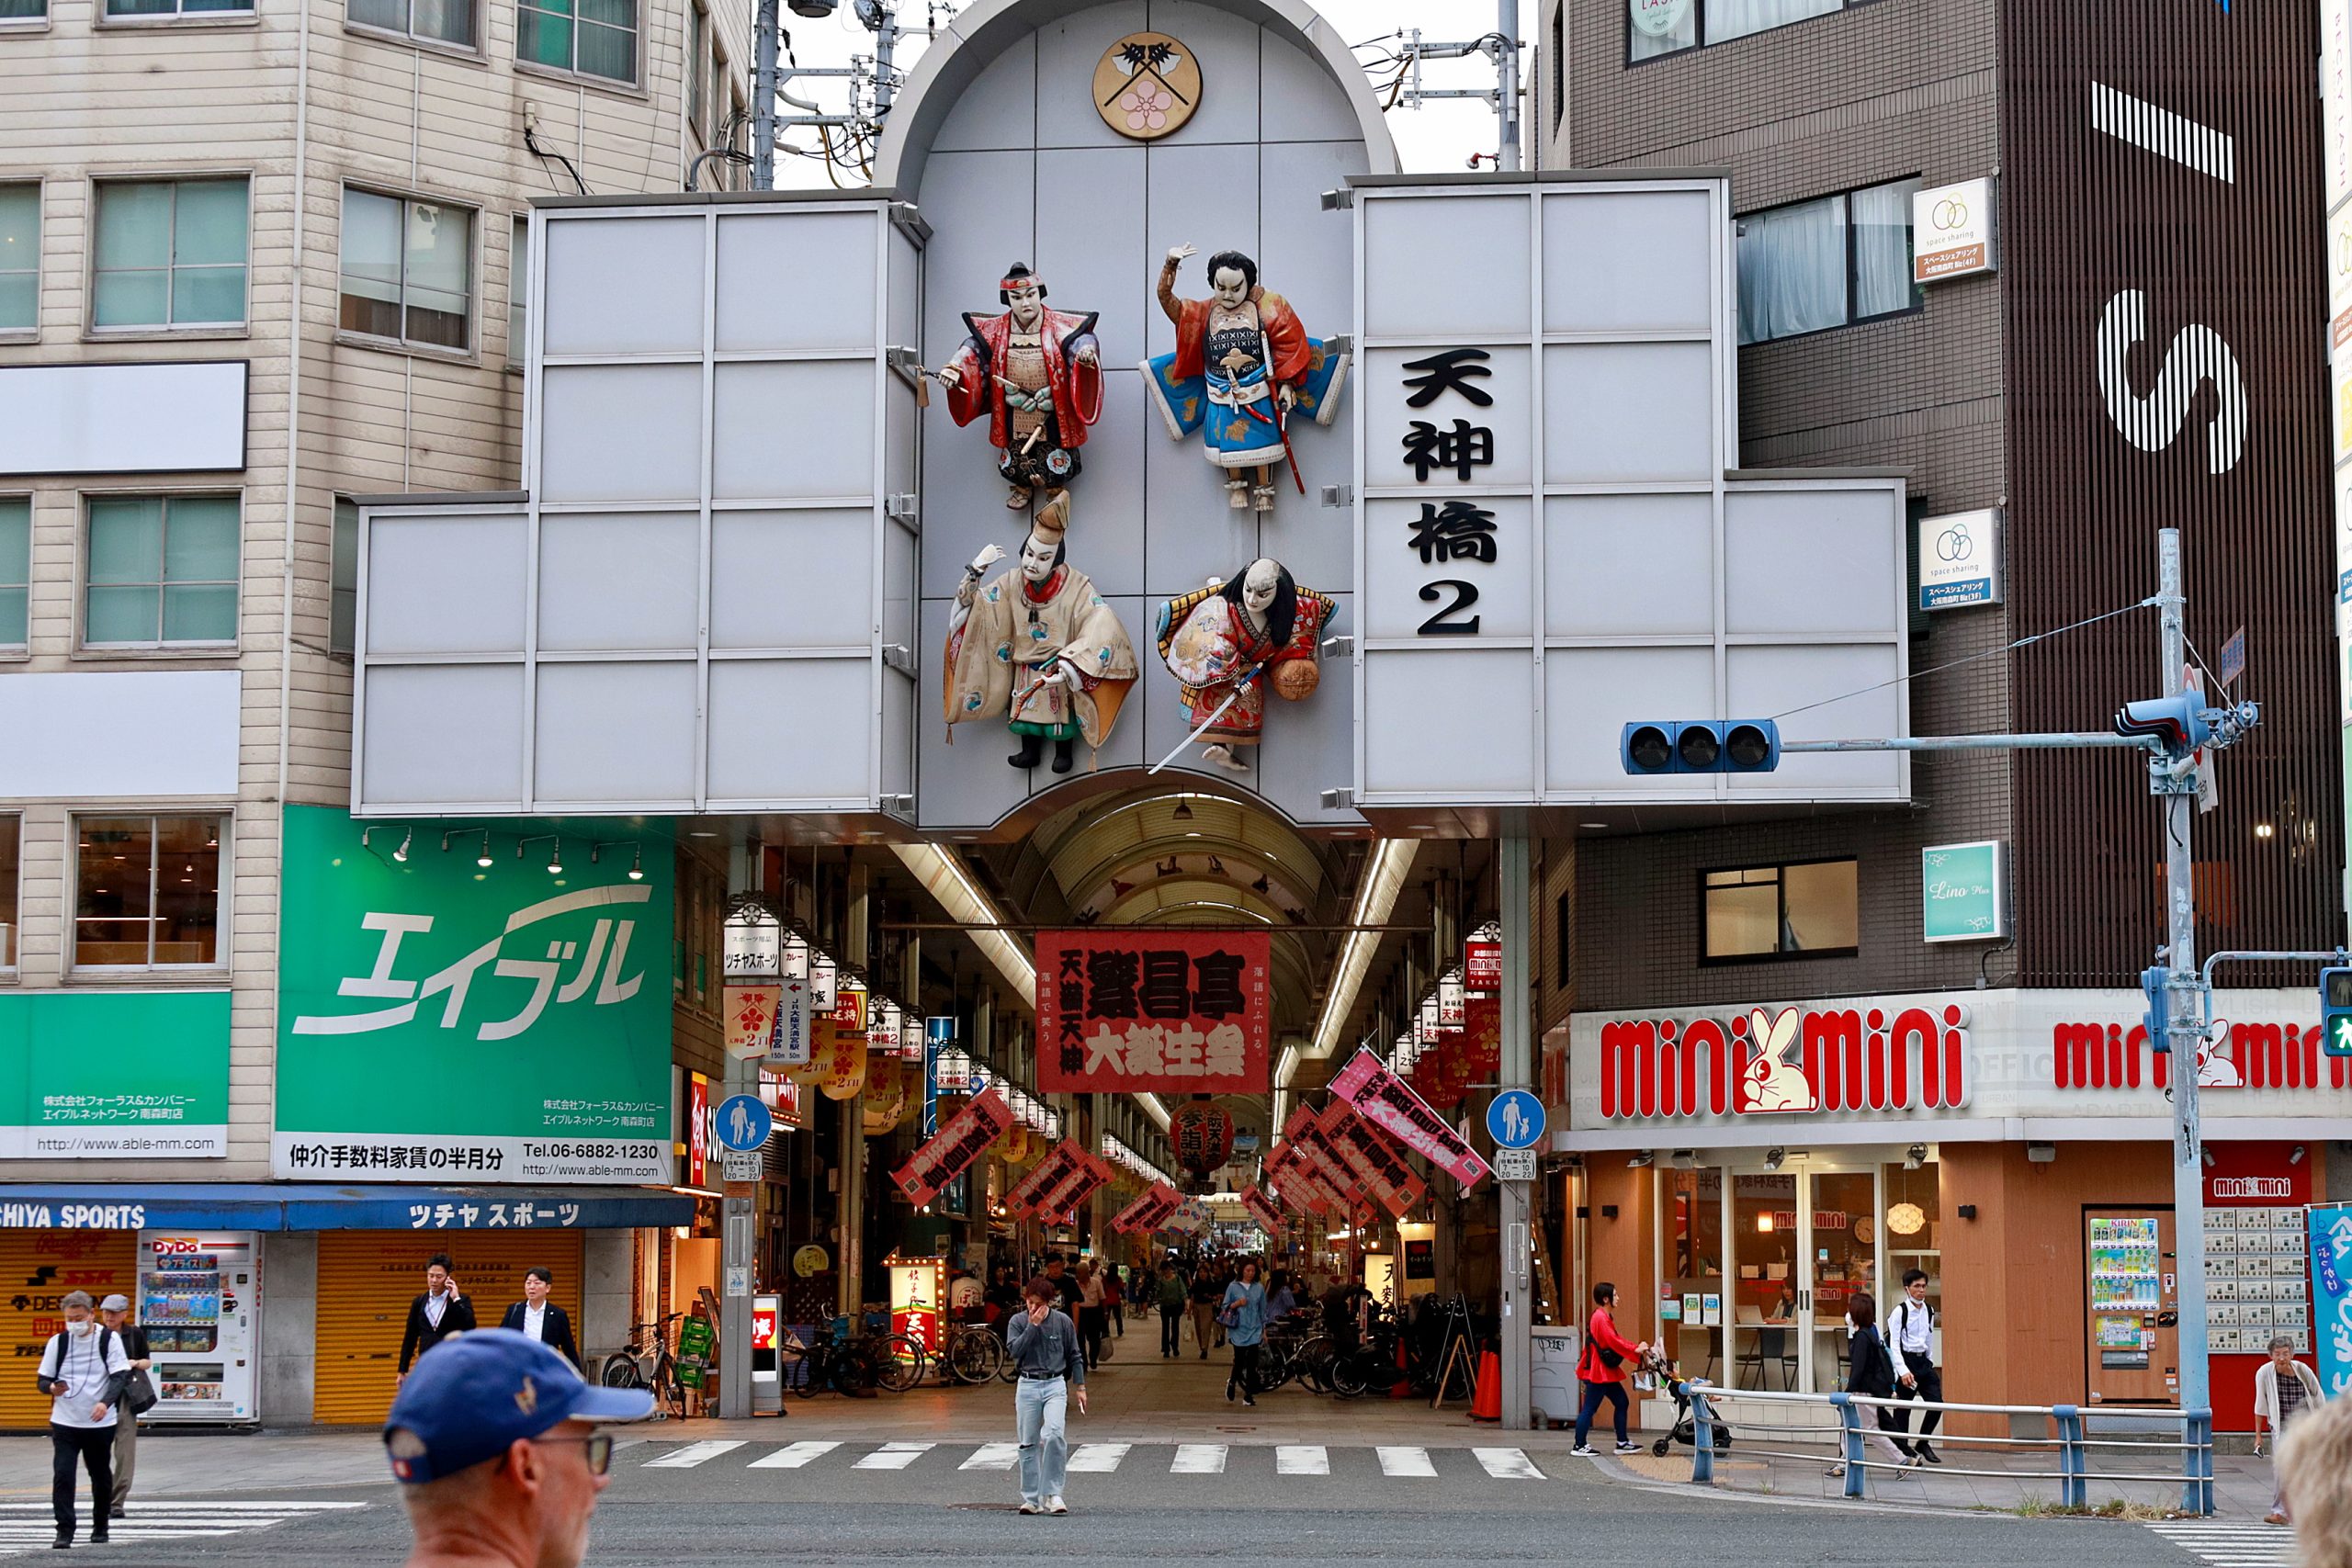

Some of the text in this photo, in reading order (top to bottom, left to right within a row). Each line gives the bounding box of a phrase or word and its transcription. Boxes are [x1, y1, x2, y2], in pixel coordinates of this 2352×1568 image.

[1927, 231, 1974, 247] space sharing
[1924, 247, 1978, 265] スペースシェアリング
[1402, 349, 1498, 635] 天神橋2
[1930, 564, 1979, 577] space sharing
[1928, 581, 1984, 596] スペースシェアリング
[1928, 881, 1968, 899] Lino
[291, 884, 653, 1041] エイブル
[725, 952, 778, 970] ツチヤスポーツ
[786, 953, 804, 961] カレー
[1085, 949, 1246, 1021] 繁昌亭
[831, 1010, 856, 1021] 王将
[1059, 949, 1084, 1077] 天満天神
[790, 998, 800, 1051] JR大阪天満宮駅
[865, 1034, 898, 1044] 天神橋2
[1600, 1003, 1963, 1119] mini mini
[2052, 1022, 2352, 1089] min min
[938, 1077, 967, 1085] 天神橋2
[42, 1108, 138, 1120] エイブルネットワーク
[543, 1114, 620, 1127] エイブルネットワーク
[38, 1137, 214, 1152] http://www.able-mm.com
[523, 1143, 659, 1159] Tel.06-6882-1230
[289, 1144, 504, 1171] 仲介手数料家賃の半月分
[522, 1164, 659, 1177] http://www.able-mm.com
[2215, 1179, 2290, 1196] mini mini
[61, 1205, 145, 1229] SPORTS
[410, 1202, 580, 1229] ツチヤ スポーツ
[2110, 1219, 2138, 1227] KIRIN
[153, 1241, 198, 1256] DyDo
[2318, 1247, 2338, 1291] ぶっかけ
